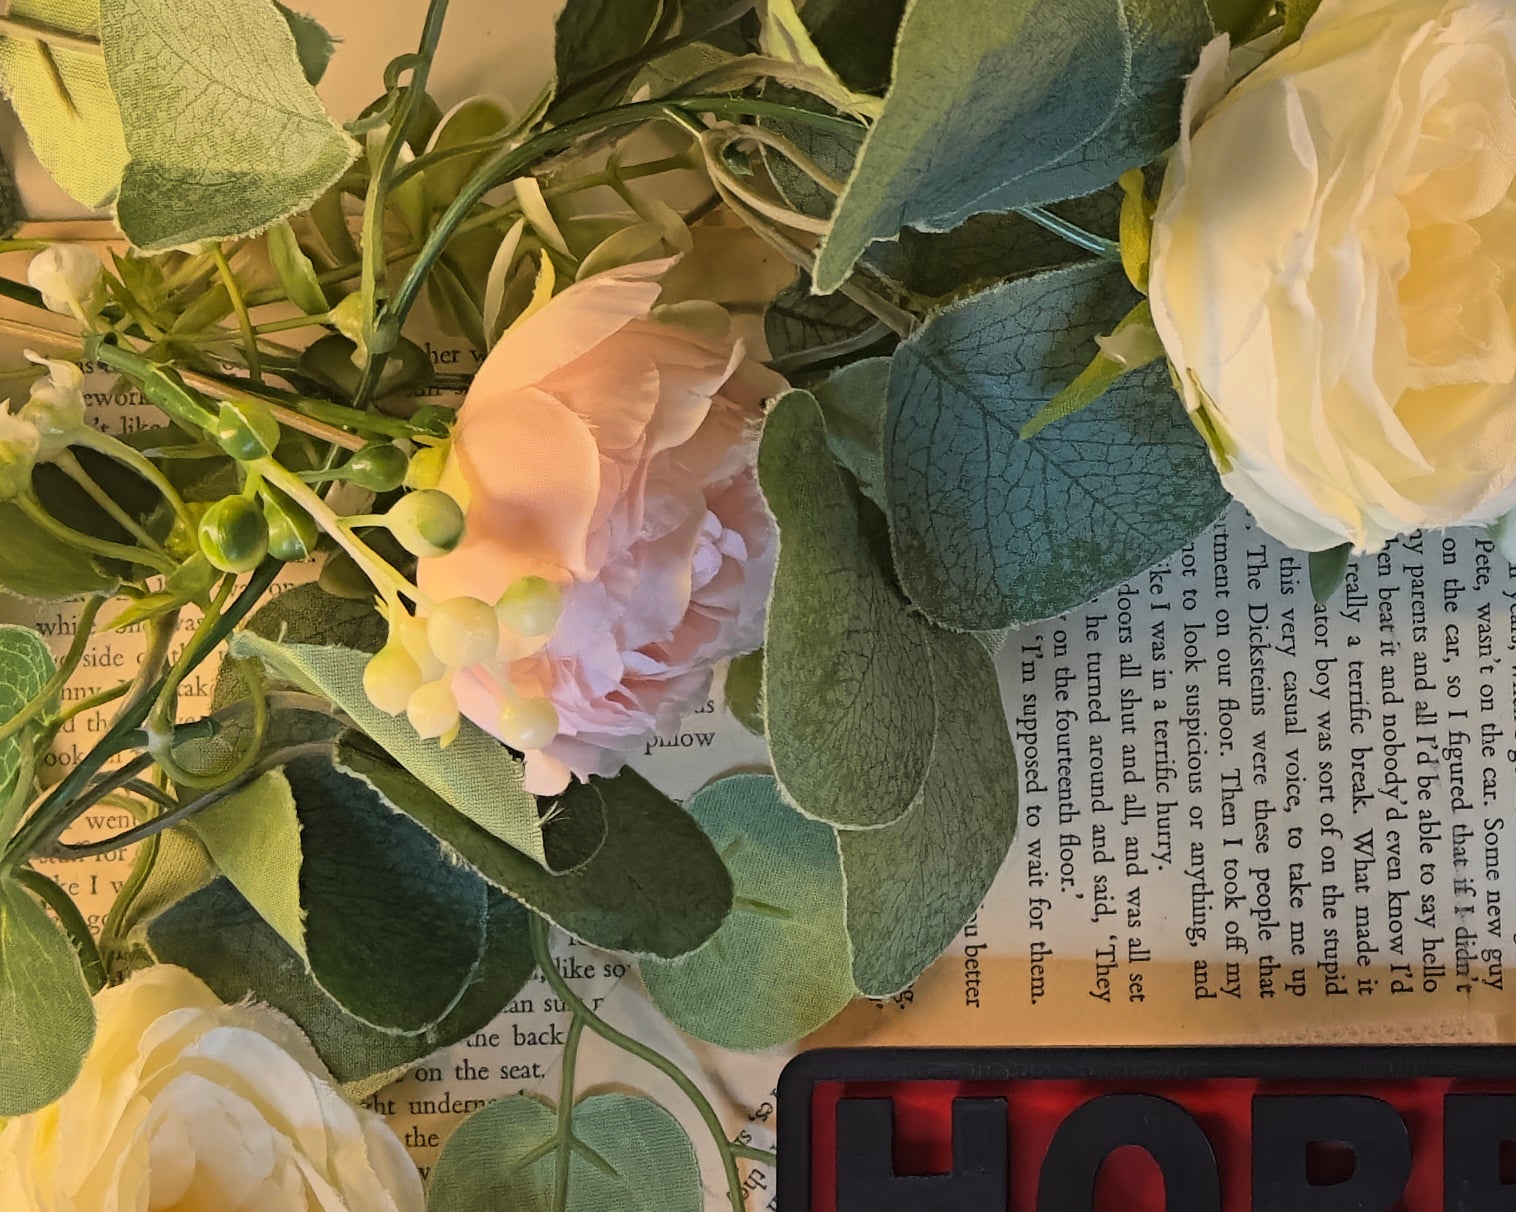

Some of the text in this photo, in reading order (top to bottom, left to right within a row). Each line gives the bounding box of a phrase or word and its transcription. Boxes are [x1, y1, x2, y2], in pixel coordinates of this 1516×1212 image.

[1471, 537, 1497, 591] Pete,
[1084, 612, 1108, 642] he
[1086, 651, 1111, 725] turned
[1479, 683, 1494, 712] on
[1015, 693, 1048, 794] supposed
[1480, 722, 1504, 758] the
[1088, 734, 1114, 814] around
[1178, 588, 1218, 1001] to look suspicious or anything, and
[1246, 543, 1284, 999] The Dicksteins were these people that
[1274, 556, 1312, 997] this very casual voice, to take me up
[1482, 767, 1497, 807] car.
[1026, 804, 1042, 827] to
[1026, 837, 1049, 888] wait
[1091, 823, 1116, 865] and
[1483, 817, 1504, 881] Some
[1028, 897, 1052, 931] for
[1090, 874, 1117, 923] said,
[1486, 889, 1502, 938] new
[1029, 940, 1053, 1005] them.
[1480, 948, 1504, 991] guy
[511, 1022, 564, 1047] back
[454, 1057, 490, 1081] the
[499, 1062, 546, 1080] seat.
